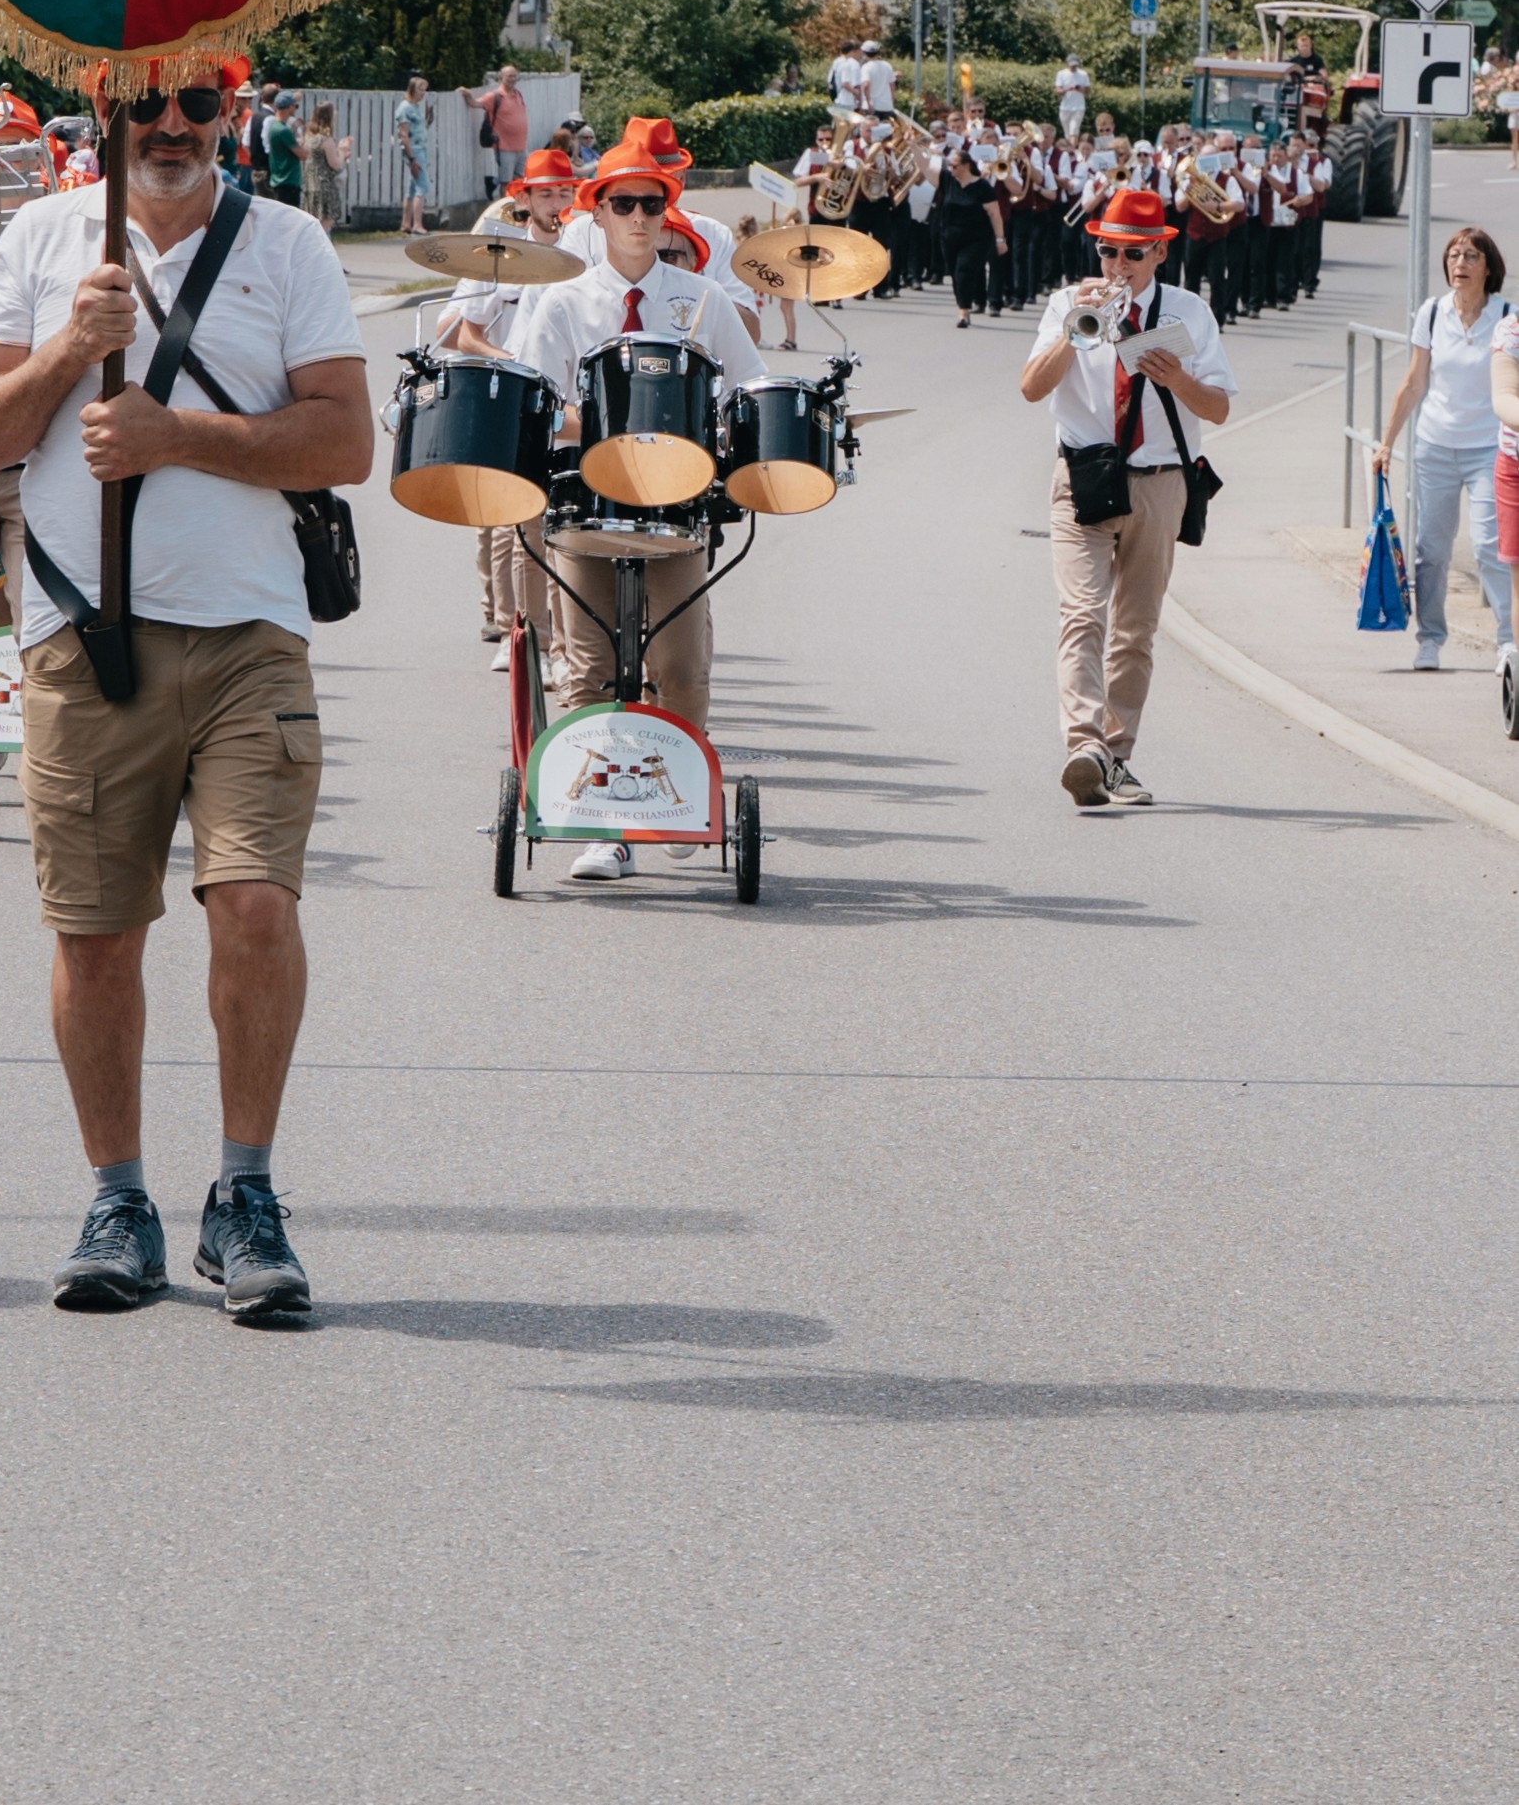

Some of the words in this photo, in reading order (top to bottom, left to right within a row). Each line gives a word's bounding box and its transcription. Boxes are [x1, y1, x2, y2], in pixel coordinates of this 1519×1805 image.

[564, 727, 618, 745] FANFARE
[638, 730, 683, 749] CLIQUE
[569, 806, 612, 819] PIERRE
[614, 811, 631, 820] DE
[633, 805, 695, 820] CHANDIEU
